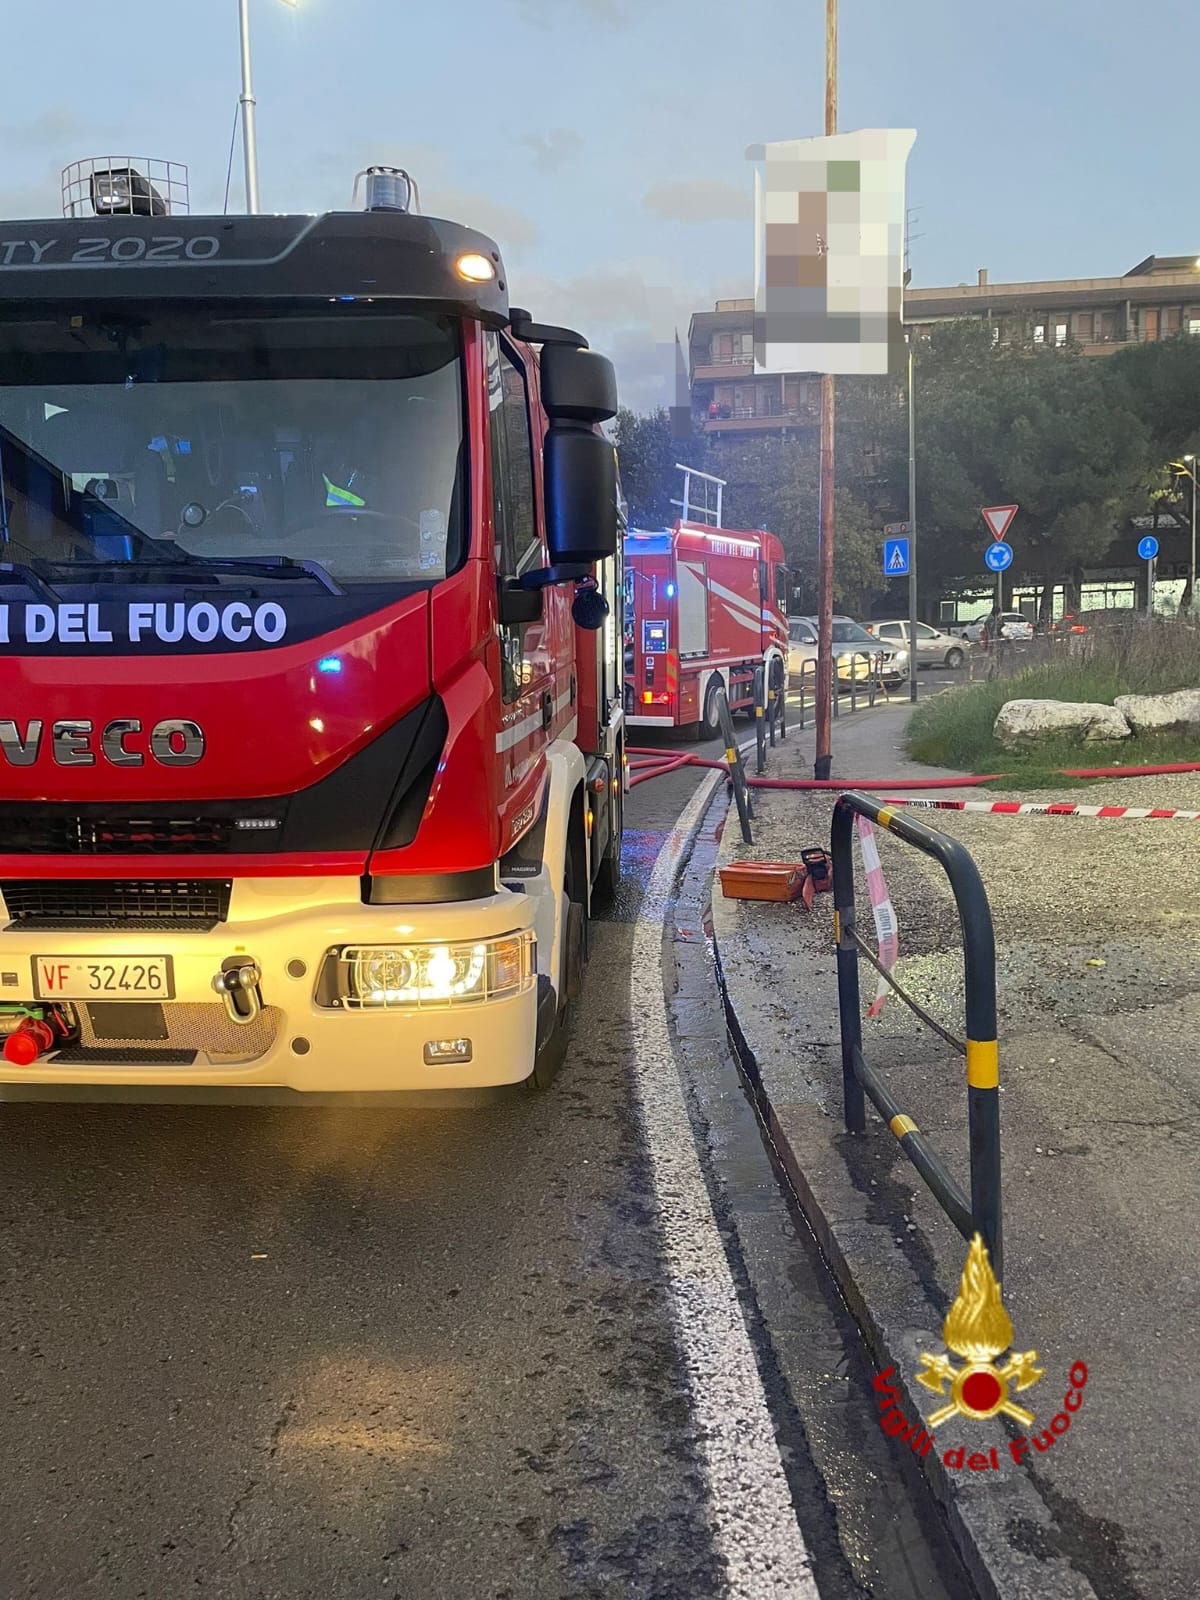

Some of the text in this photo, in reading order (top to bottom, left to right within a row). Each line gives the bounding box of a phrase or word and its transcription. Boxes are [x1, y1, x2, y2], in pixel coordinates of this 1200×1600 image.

[1, 236, 220, 264] TY 2020
[25, 603, 113, 643] DEL
[128, 602, 287, 643] FUOCO
[43, 965, 162, 991] VF 32426
